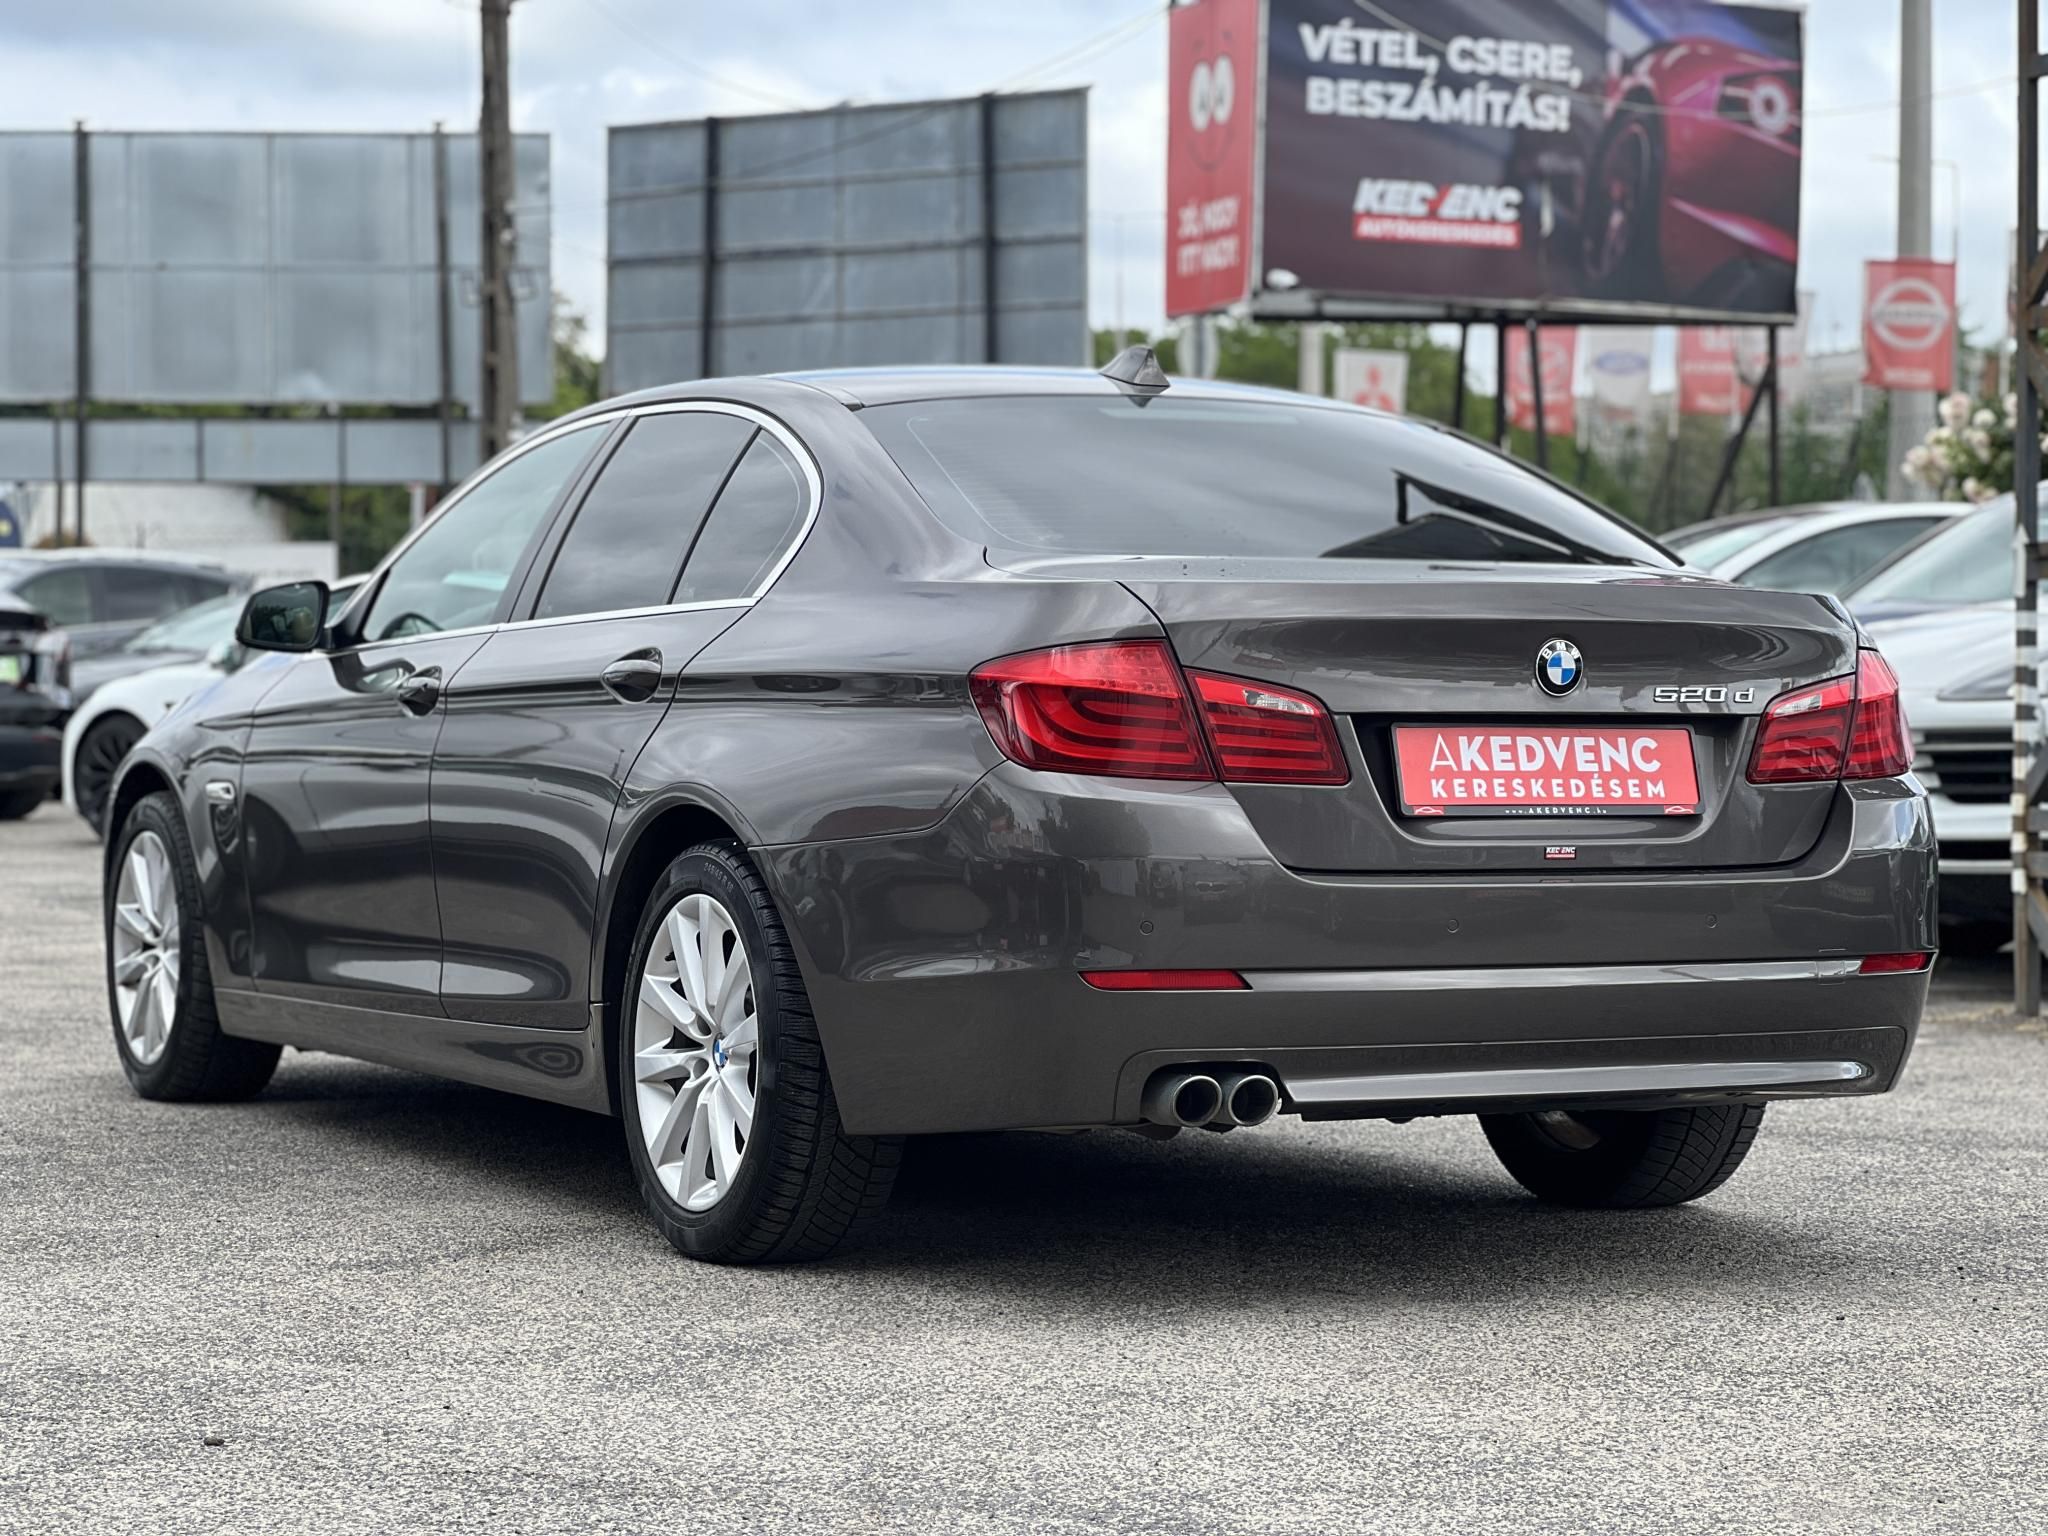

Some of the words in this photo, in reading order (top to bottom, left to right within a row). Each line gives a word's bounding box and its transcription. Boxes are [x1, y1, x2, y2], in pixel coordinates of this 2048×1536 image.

[1299, 17, 1439, 76] VÉTEL,
[1446, 35, 1583, 88] CSERE,
[1306, 76, 1571, 132] BESZÁMÍTÁS!
[1541, 641, 1581, 660] BMW
[1654, 687, 1728, 702] 520
[1431, 772, 1666, 798] KERESKEDÉSEM
